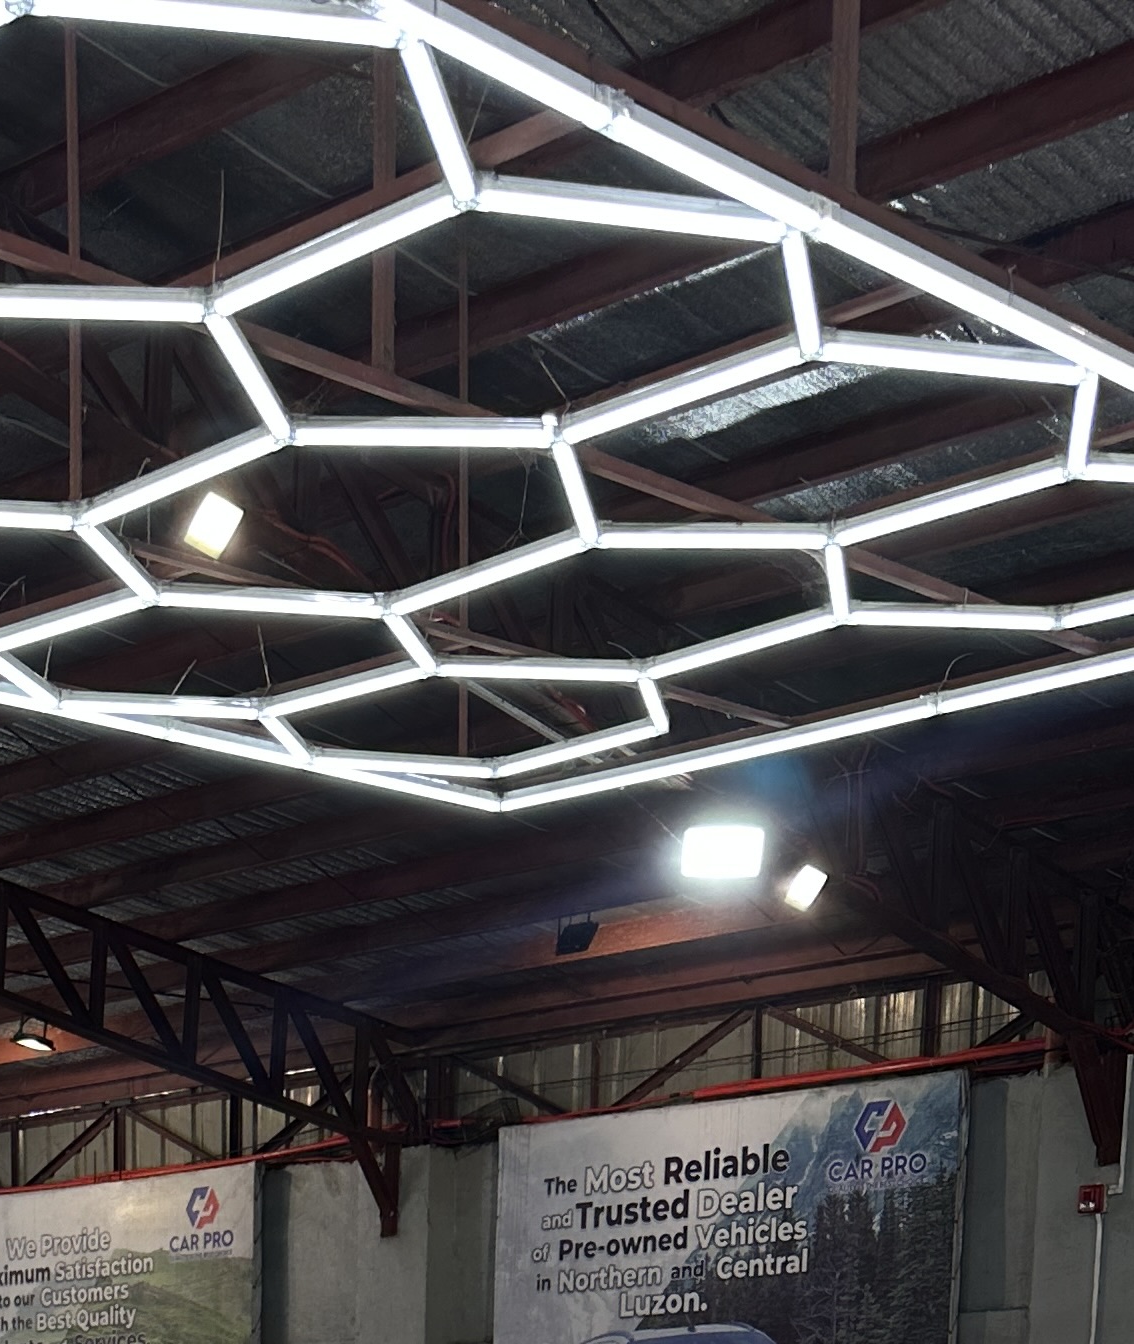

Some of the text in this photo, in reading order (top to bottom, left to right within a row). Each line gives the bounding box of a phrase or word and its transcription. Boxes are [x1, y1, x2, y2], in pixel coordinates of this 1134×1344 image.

[544, 1143, 790, 1196] The Most Reliable
[828, 1153, 927, 1182] CAR PRO
[541, 1182, 799, 1230] and Trusted Dealer
[6, 1227, 111, 1261] We Provide
[169, 1229, 234, 1253] CAR PRO
[532, 1217, 808, 1263] of Pre-owned Vehicles
[55, 1253, 154, 1283] Satisfaction
[536, 1248, 808, 1293] in Northern and Central
[13, 1294, 35, 1307] our
[41, 1283, 129, 1307] Customers
[619, 1290, 708, 1318] Luzon.
[12, 1315, 33, 1331] the
[36, 1311, 72, 1333] Best
[76, 1303, 137, 1332] Quality
